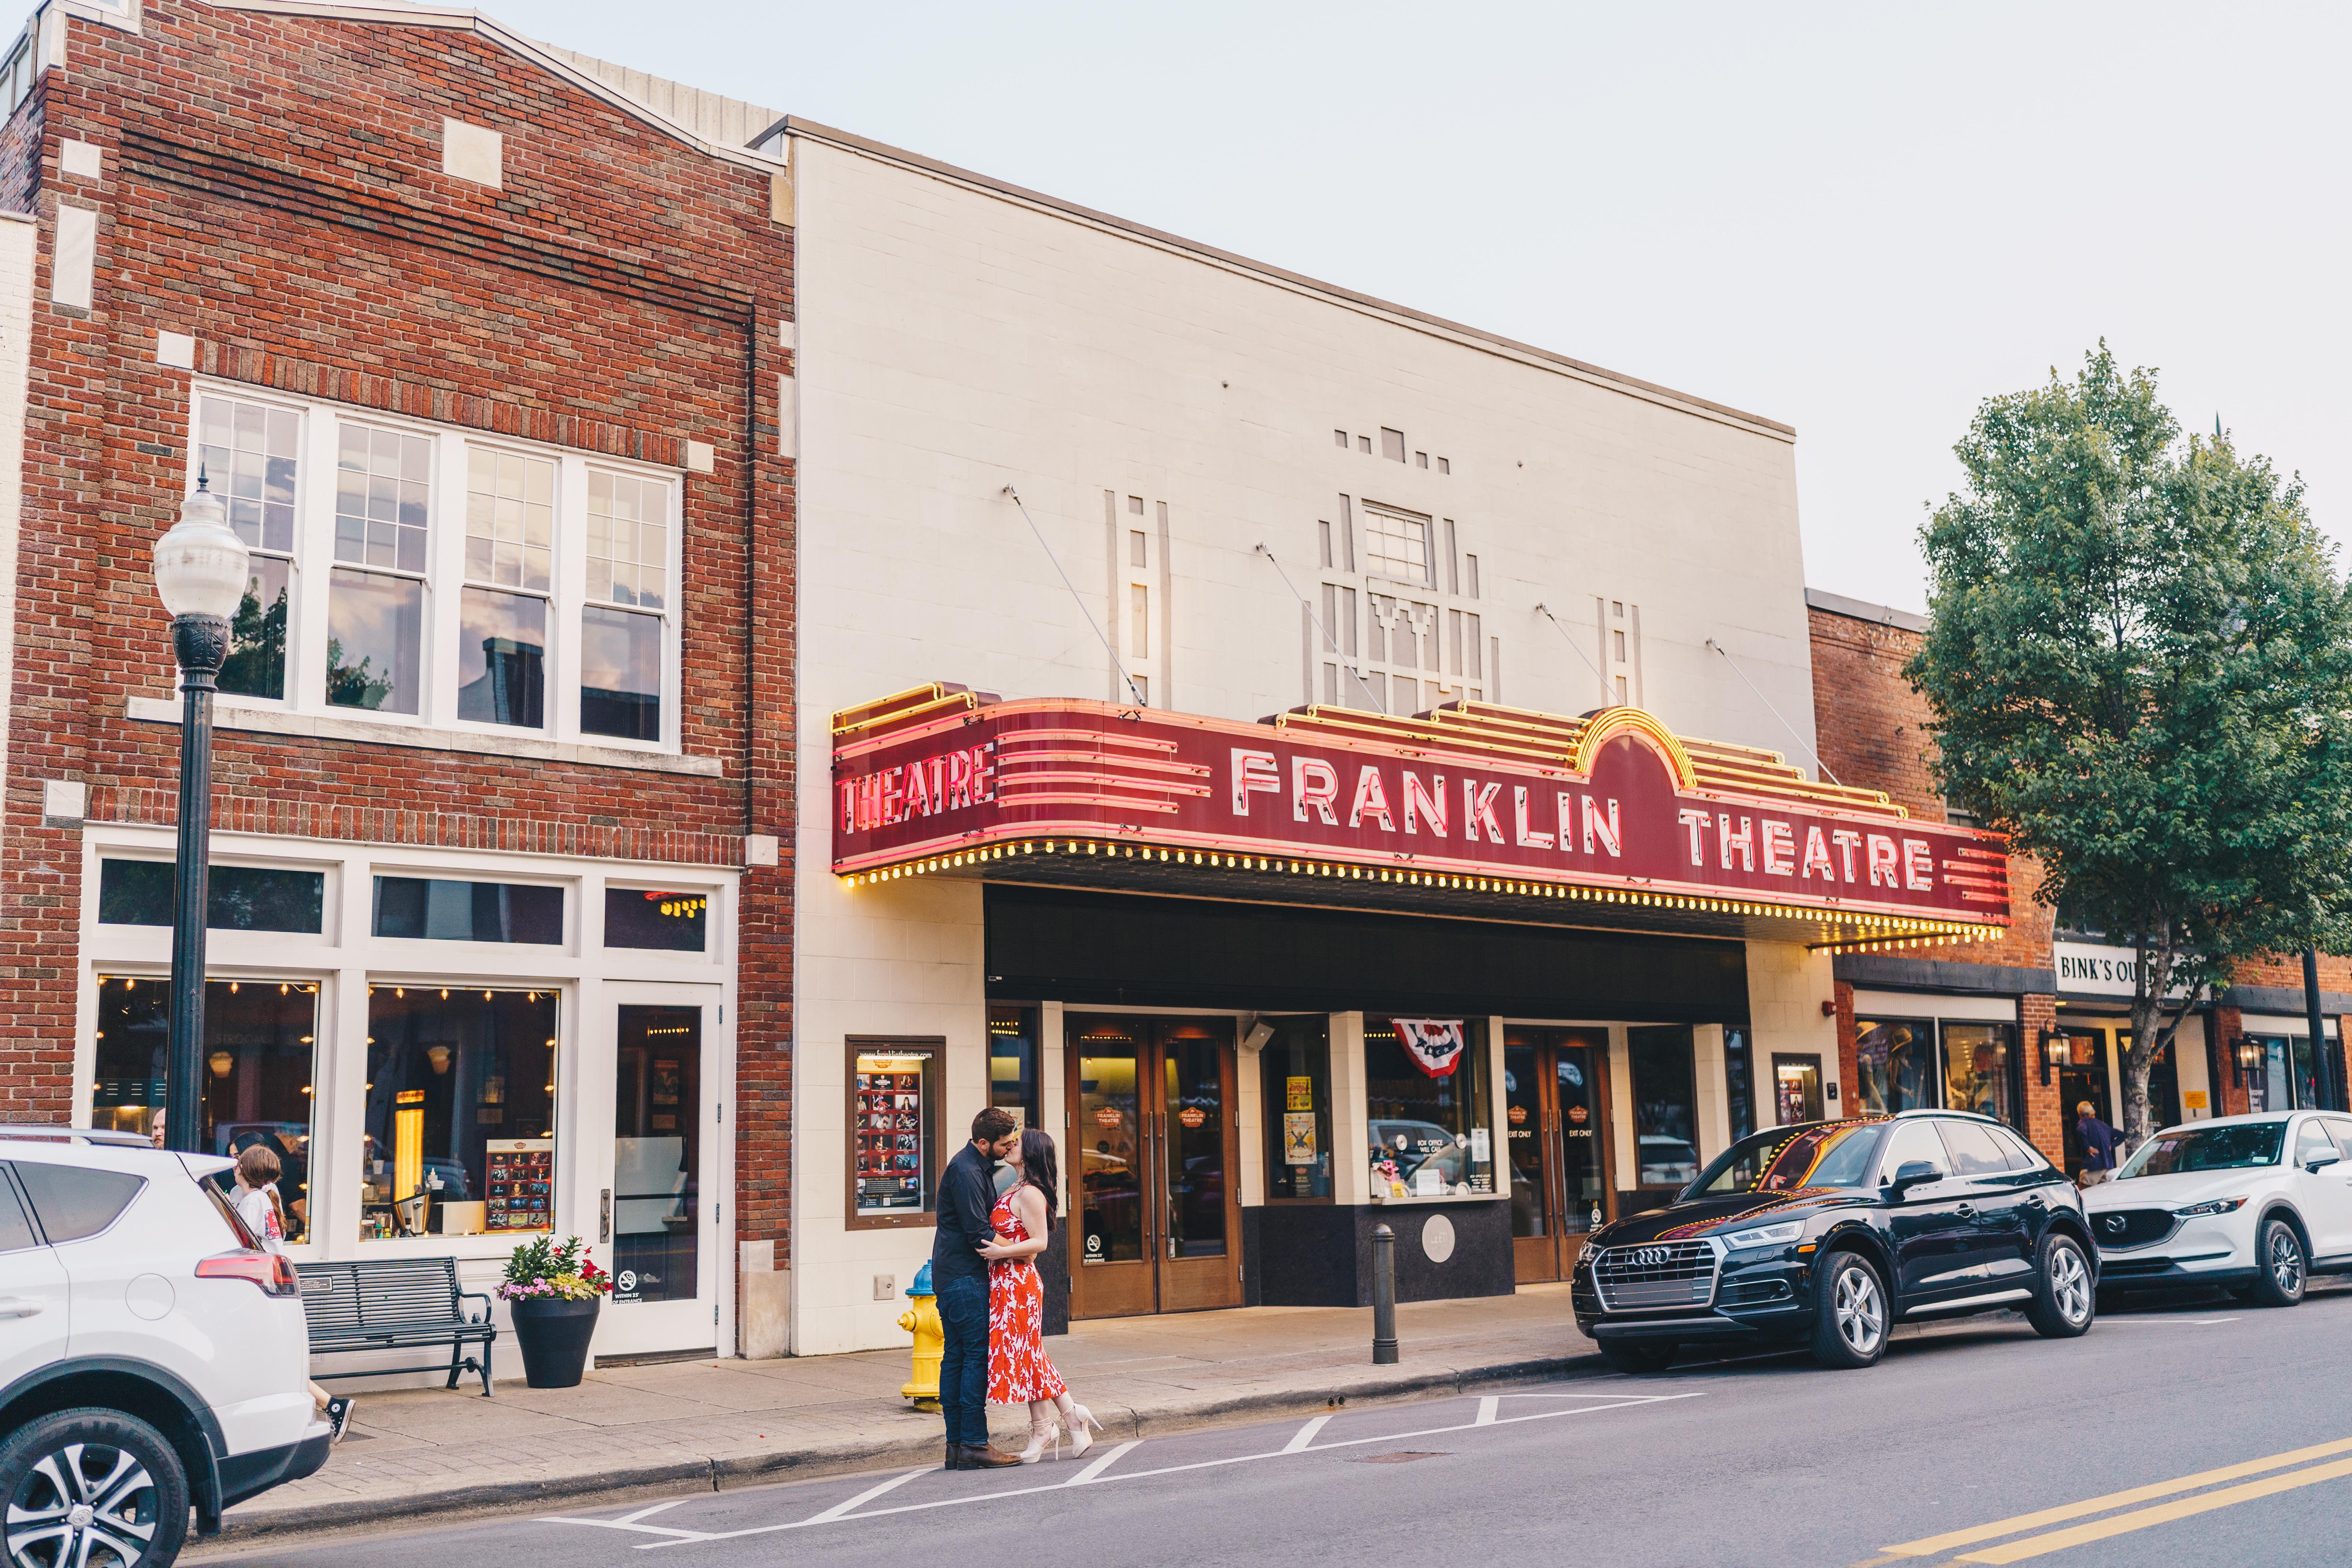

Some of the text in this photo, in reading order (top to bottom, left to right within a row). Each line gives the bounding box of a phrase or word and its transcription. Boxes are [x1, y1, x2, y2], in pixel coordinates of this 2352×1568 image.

[835, 742, 995, 835] THEATRE
[1231, 748, 1934, 892] FRANKLIN THEATRE
[2061, 956, 2112, 981] BINK'S
[860, 1050, 932, 1059] wwwfranklintheatrecom
